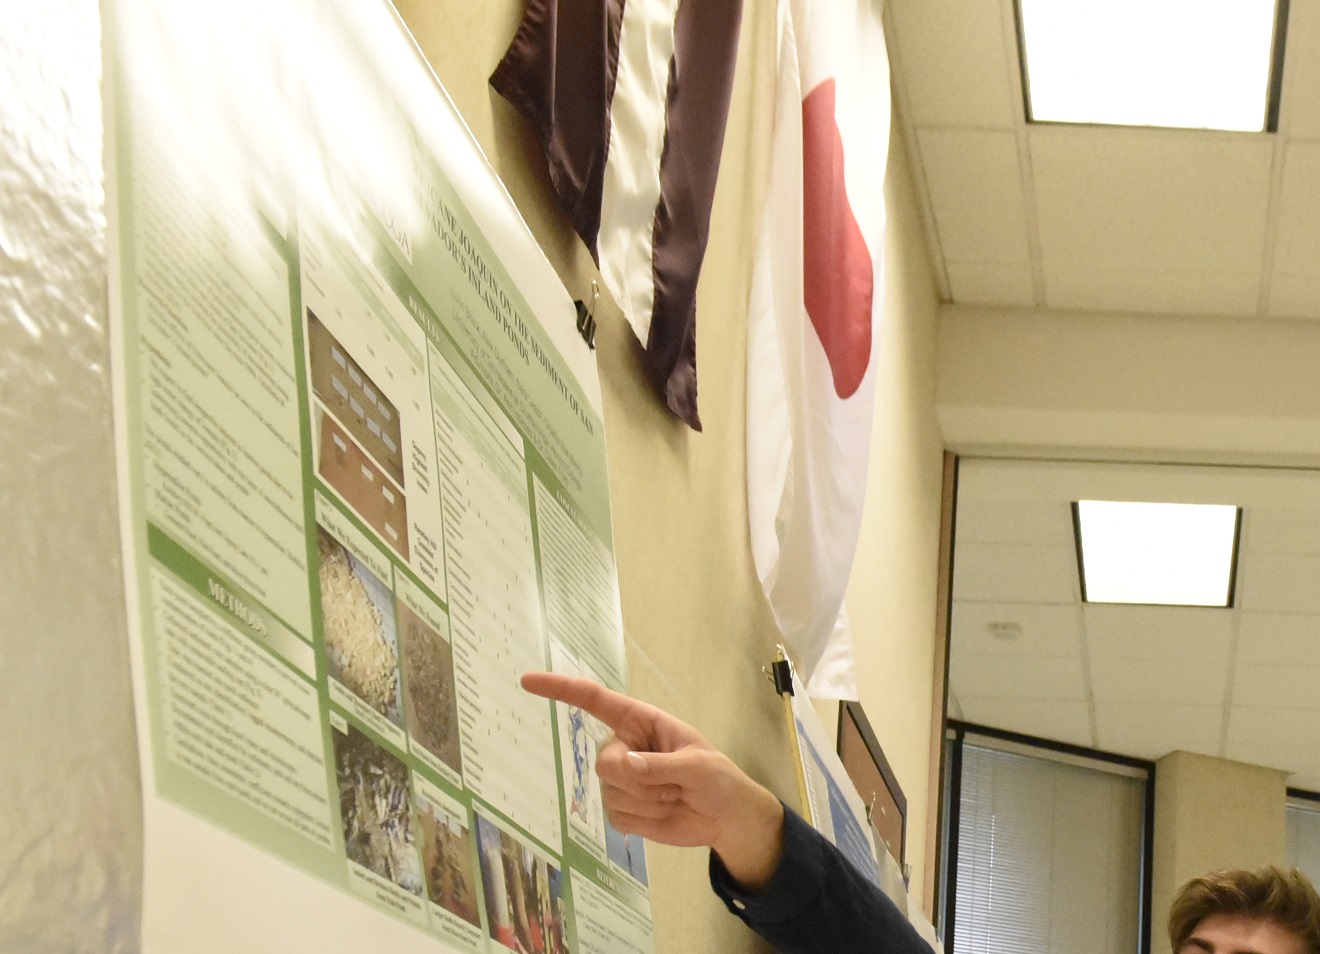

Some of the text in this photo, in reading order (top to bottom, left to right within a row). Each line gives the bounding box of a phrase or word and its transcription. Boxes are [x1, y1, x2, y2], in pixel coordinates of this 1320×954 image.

[459, 228, 499, 297] JOAQUIN
[499, 290, 512, 319] ON
[513, 309, 530, 342] THE
[530, 335, 569, 399] SEDIMENT
[569, 394, 579, 415] OF
[468, 265, 502, 324] INLAND
[503, 323, 529, 366] PONDS
[208, 578, 267, 638] METHODS
